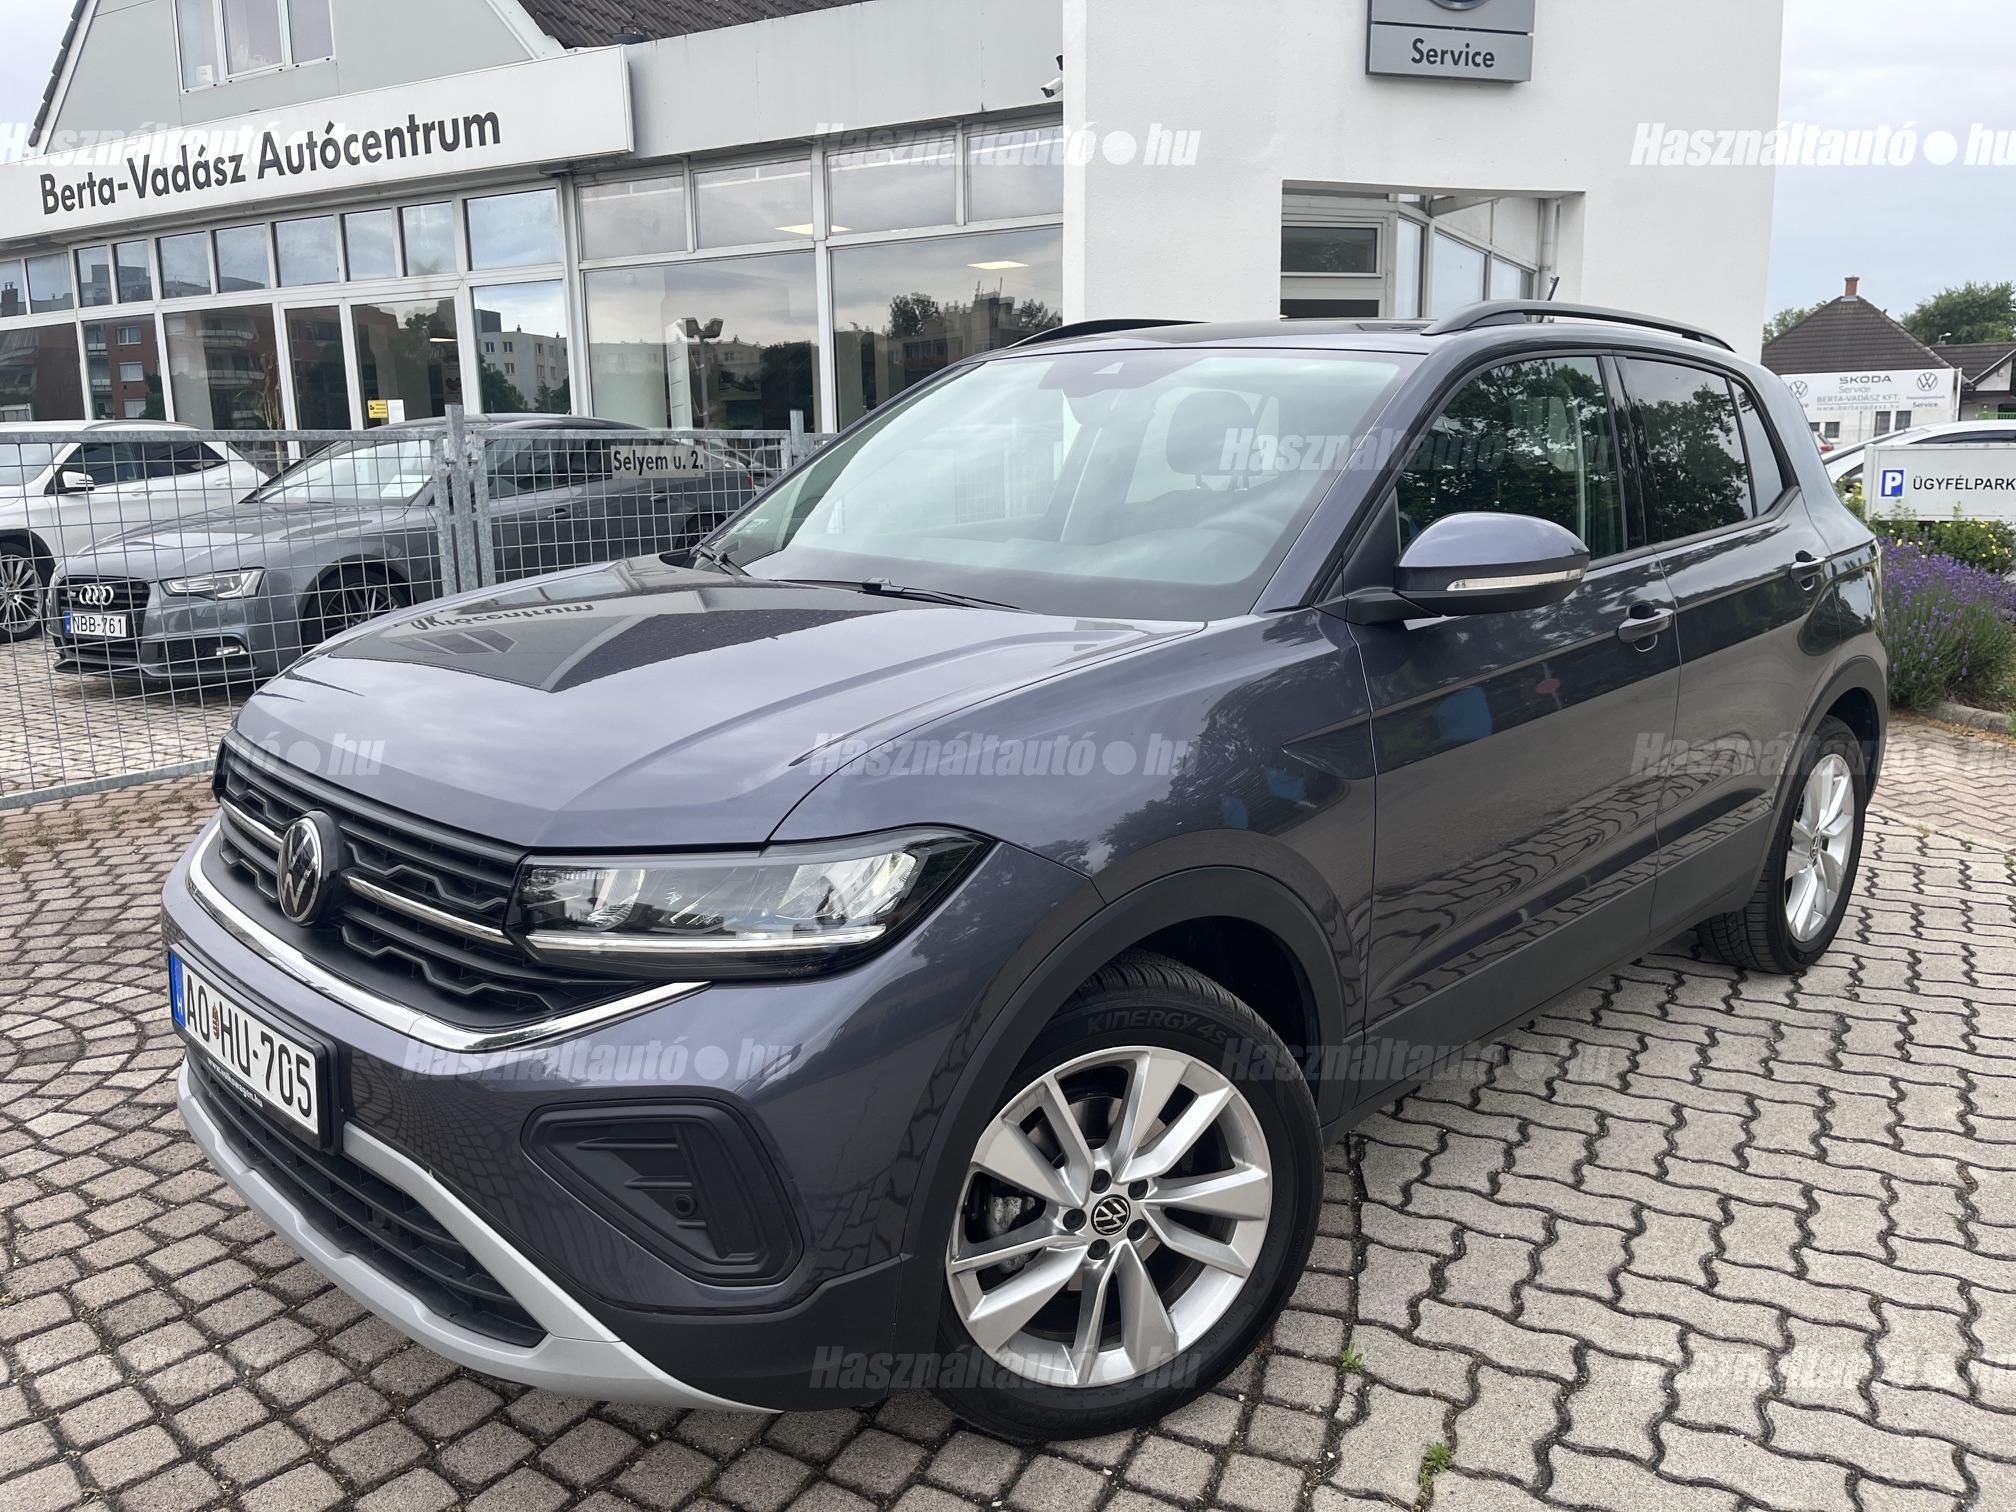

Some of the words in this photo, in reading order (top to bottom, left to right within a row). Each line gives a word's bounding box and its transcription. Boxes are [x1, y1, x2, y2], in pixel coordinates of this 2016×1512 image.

[1411, 38, 1495, 68] Service
[40, 144, 246, 215] Berta-Vadász
[257, 110, 501, 180] Autócentrum
[614, 449, 668, 476] Selyem
[673, 455, 686, 470] u.
[690, 449, 704, 470] 2.
[1913, 475, 2016, 490] ÜGYFÉLPARK
[73, 615, 122, 635] NBB-761
[1088, 1010, 1198, 1035] KINERGY
